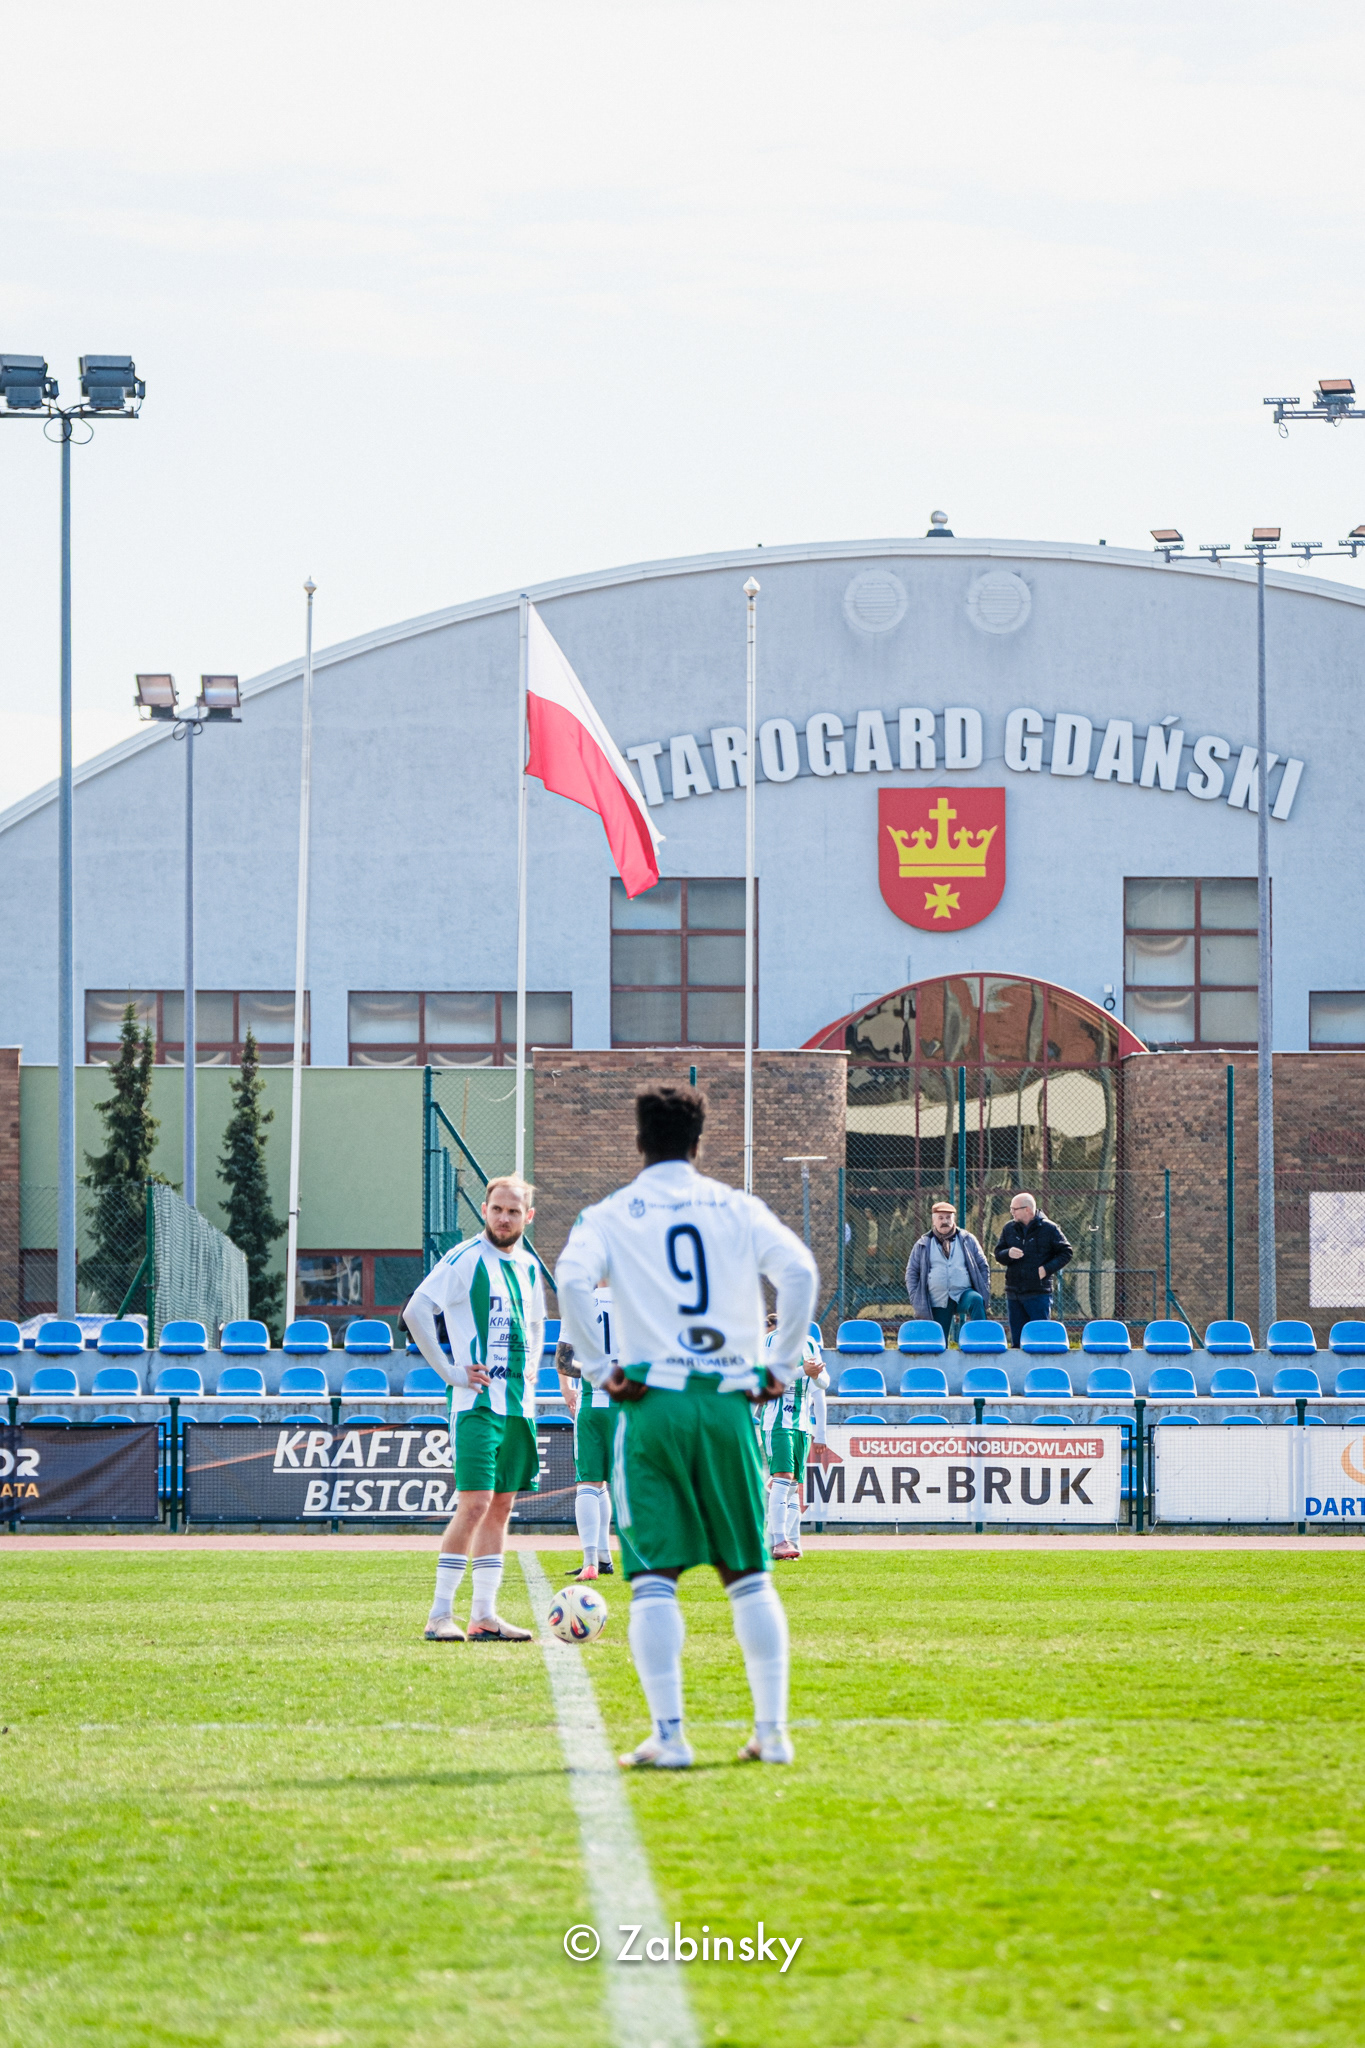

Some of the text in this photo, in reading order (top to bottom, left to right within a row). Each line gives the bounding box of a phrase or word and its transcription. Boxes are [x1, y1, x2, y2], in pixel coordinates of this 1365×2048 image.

[625, 706, 1304, 821] TAROGARD GDAŃSKI
[666, 1223, 709, 1316] 9
[859, 1438, 1097, 1456] USŁUGI OGÓLNOBUDOWLANE
[806, 1466, 1094, 1505] MAR-BRUK
